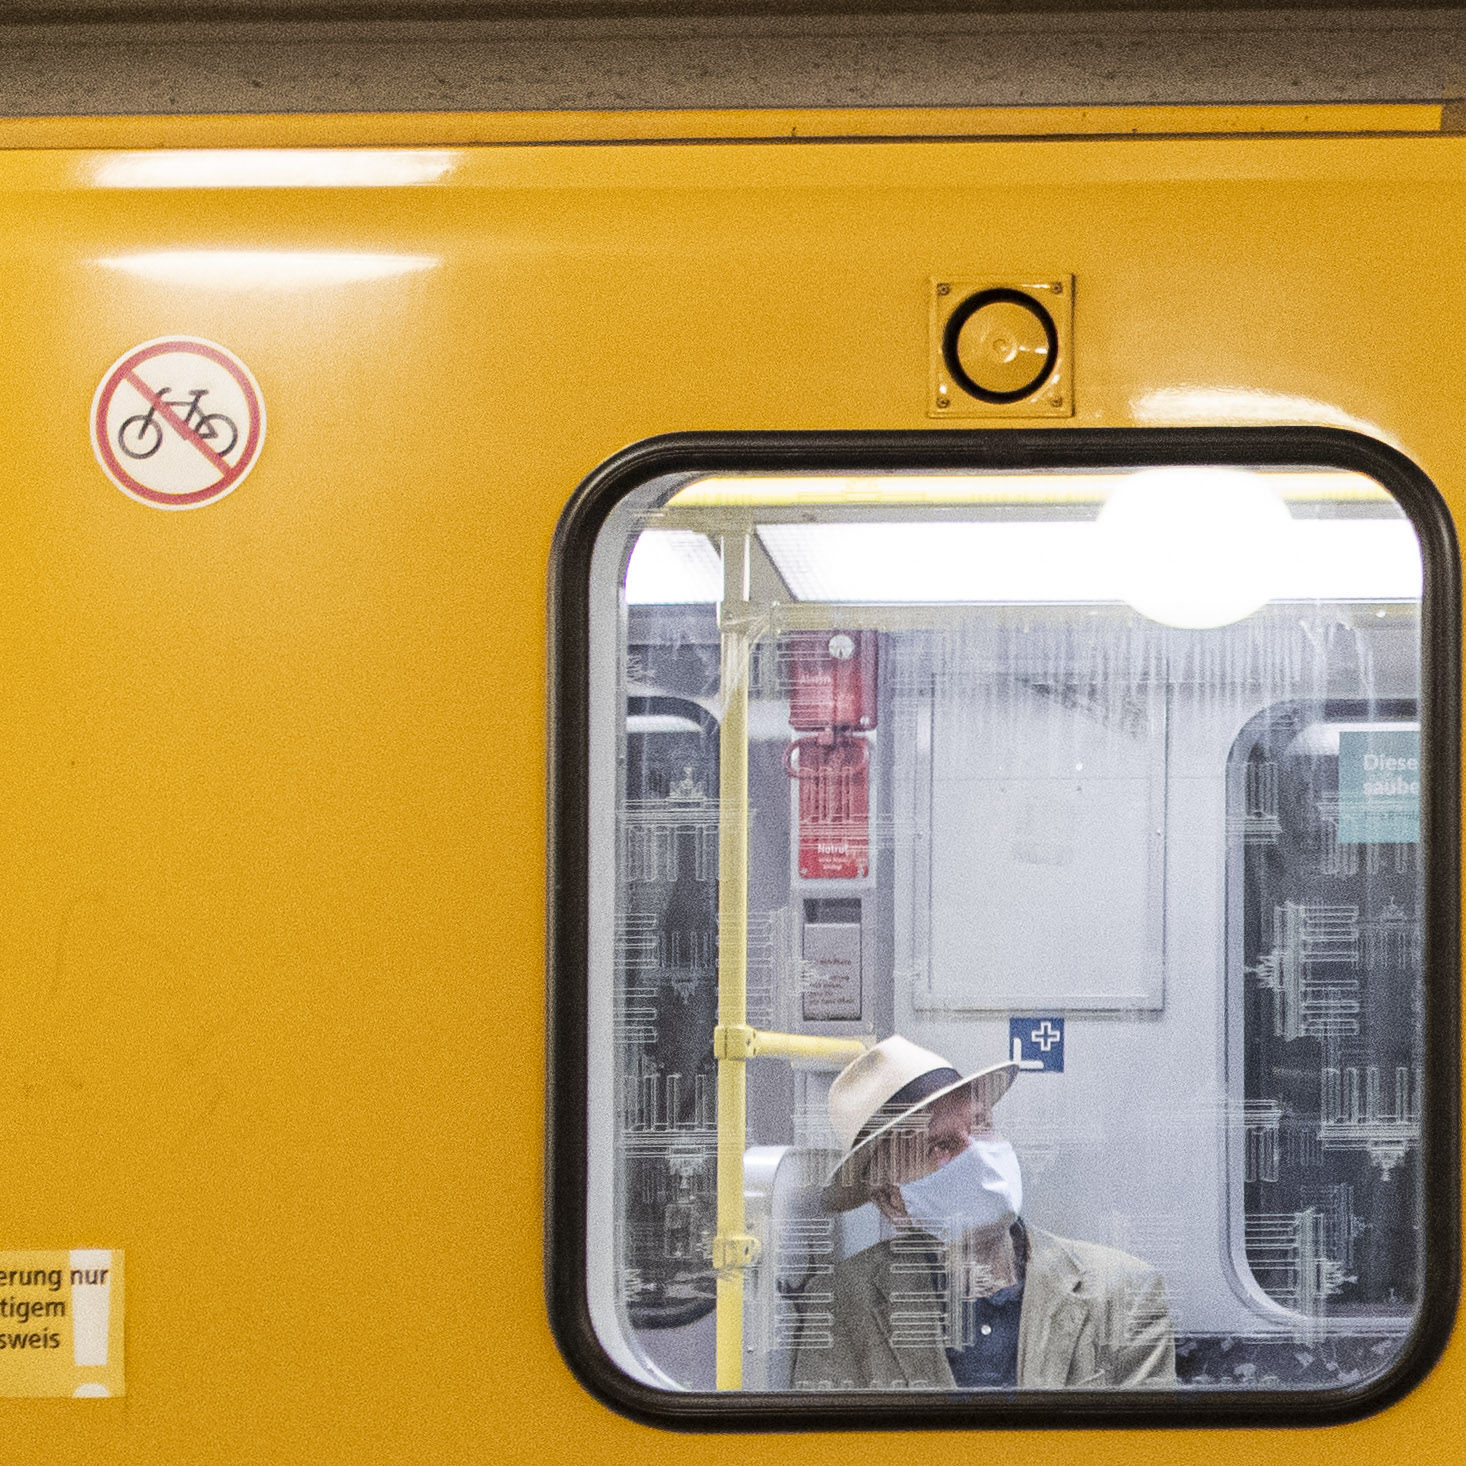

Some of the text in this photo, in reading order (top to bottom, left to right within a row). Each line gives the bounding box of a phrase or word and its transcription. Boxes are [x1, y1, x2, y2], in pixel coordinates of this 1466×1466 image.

[0, 1268, 109, 1292] erung nur
[0, 1297, 66, 1323] tigem
[0, 1327, 61, 1349] sweis
